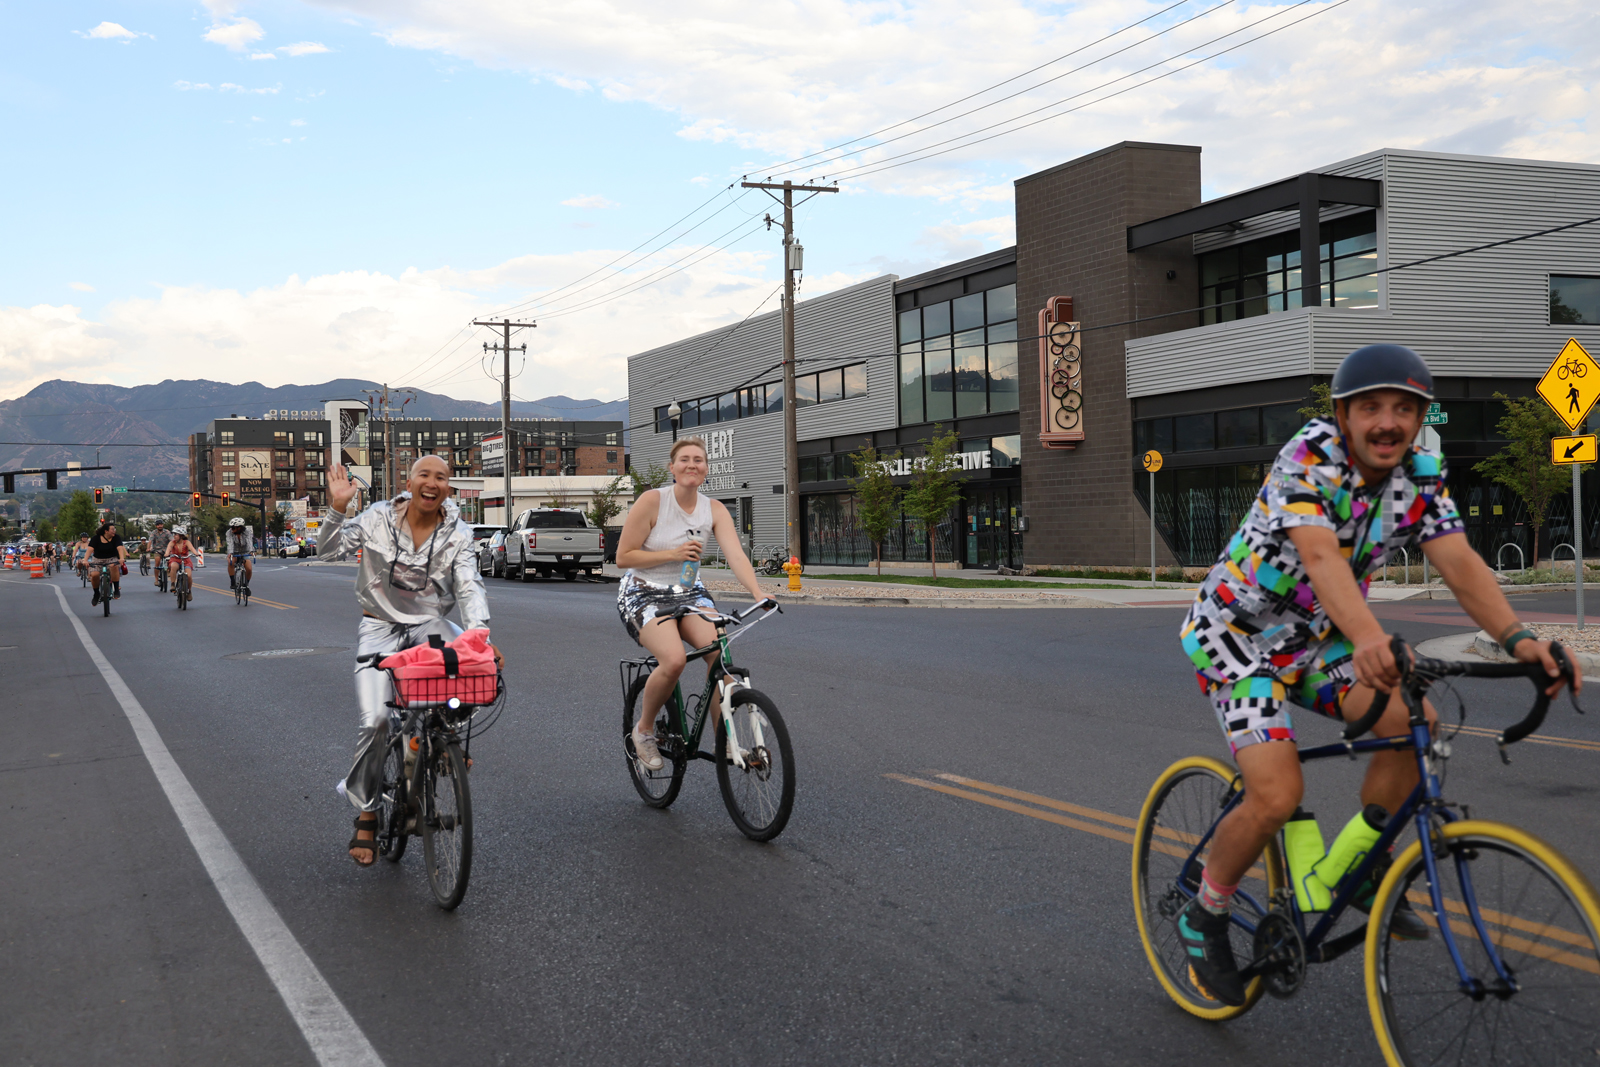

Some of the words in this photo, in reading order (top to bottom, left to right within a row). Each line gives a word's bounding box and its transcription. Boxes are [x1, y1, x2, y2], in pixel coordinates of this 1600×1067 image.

[1430, 415, 1440, 423] Blvd
[492, 442, 504, 451] TIRES
[711, 460, 735, 475] BICYCLE
[1142, 453, 1152, 469] 9
[710, 475, 736, 491] CENTER
